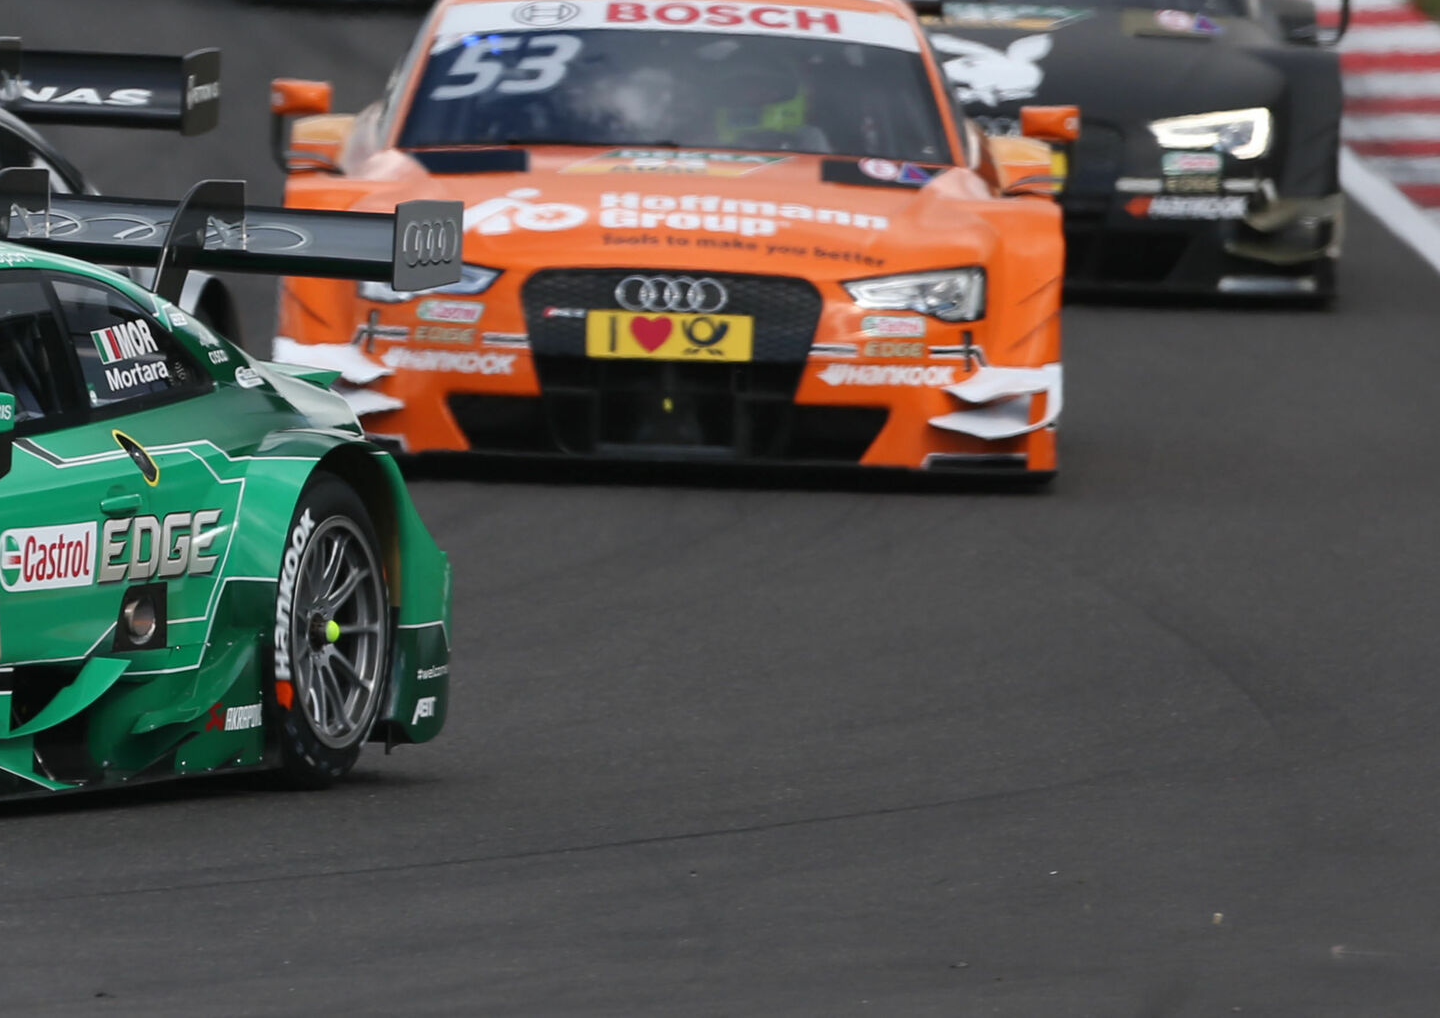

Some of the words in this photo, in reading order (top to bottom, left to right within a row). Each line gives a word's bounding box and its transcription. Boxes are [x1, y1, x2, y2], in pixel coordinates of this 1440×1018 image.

[605, 1, 843, 35] BOSCH
[429, 33, 584, 102] 53
[599, 207, 779, 237] Group
[600, 192, 890, 230] Hoffmann
[601, 232, 659, 246] Tools
[666, 234, 690, 247] to
[696, 236, 758, 251] make
[765, 243, 807, 256] you
[812, 246, 886, 268] better
[111, 318, 159, 360] MOR
[863, 341, 925, 358] EDGE
[105, 360, 170, 392] Mortara
[23, 530, 90, 583] Castrol
[98, 508, 224, 585] EDGE
